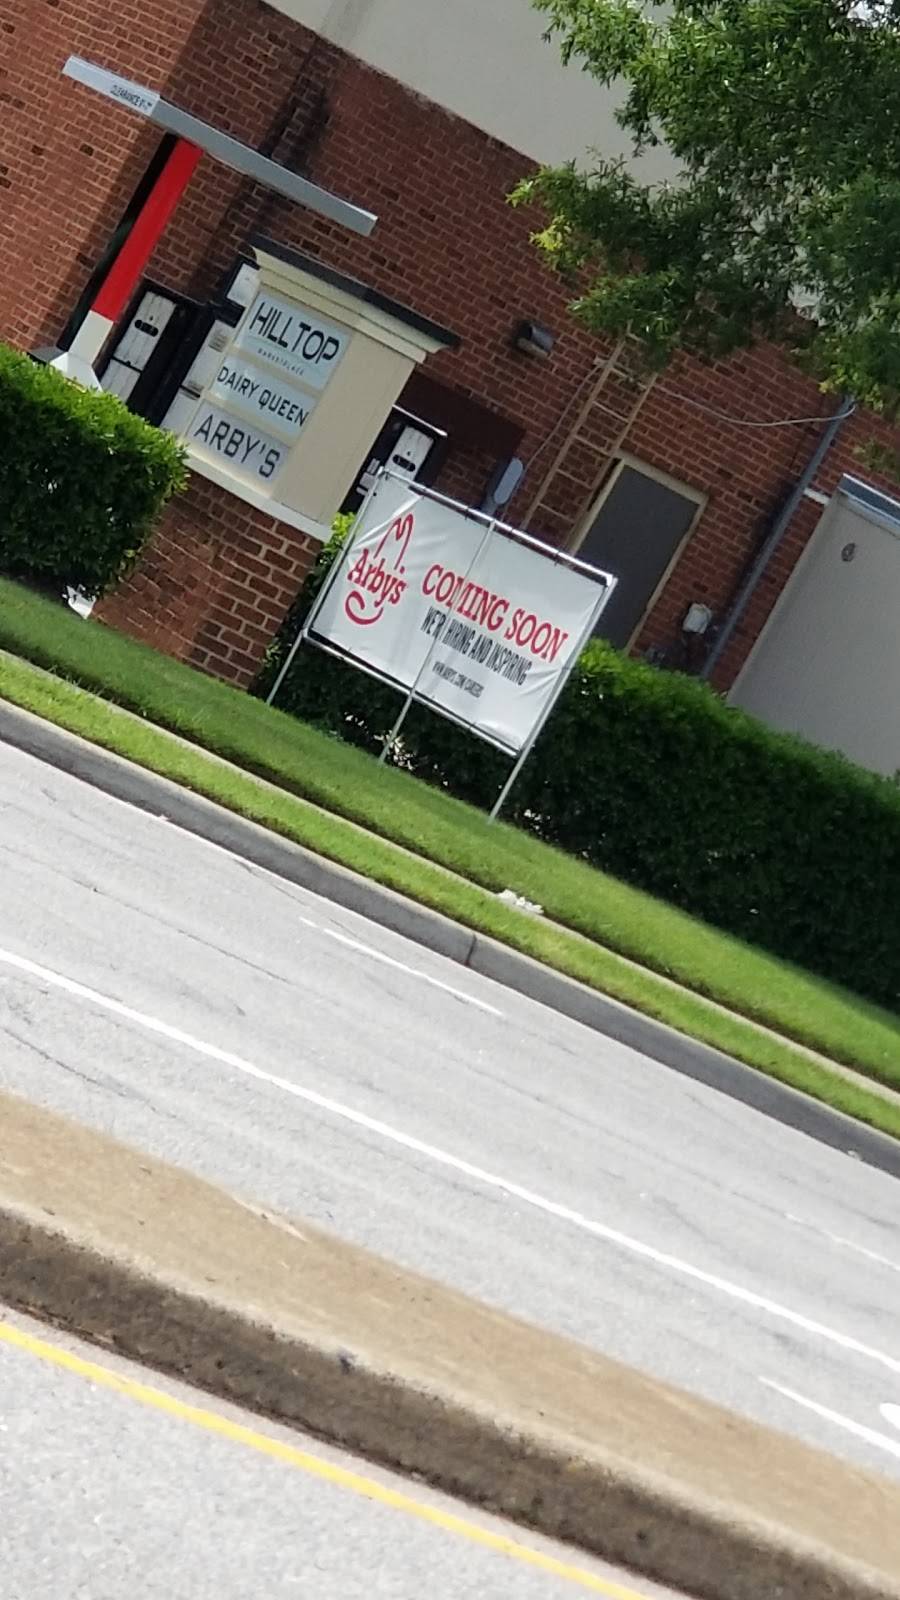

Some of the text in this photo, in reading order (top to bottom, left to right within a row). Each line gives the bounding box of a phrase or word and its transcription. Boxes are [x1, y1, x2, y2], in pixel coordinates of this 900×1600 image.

[249, 301, 340, 365] HILLTOP
[216, 366, 309, 427] DAIRY QUEEN
[193, 413, 281, 478] ARBY'S
[422, 564, 569, 663] COMING SOON
[442, 619, 476, 655] HIRING
[468, 634, 493, 664] AND
[485, 642, 533, 687] INSPIRING
